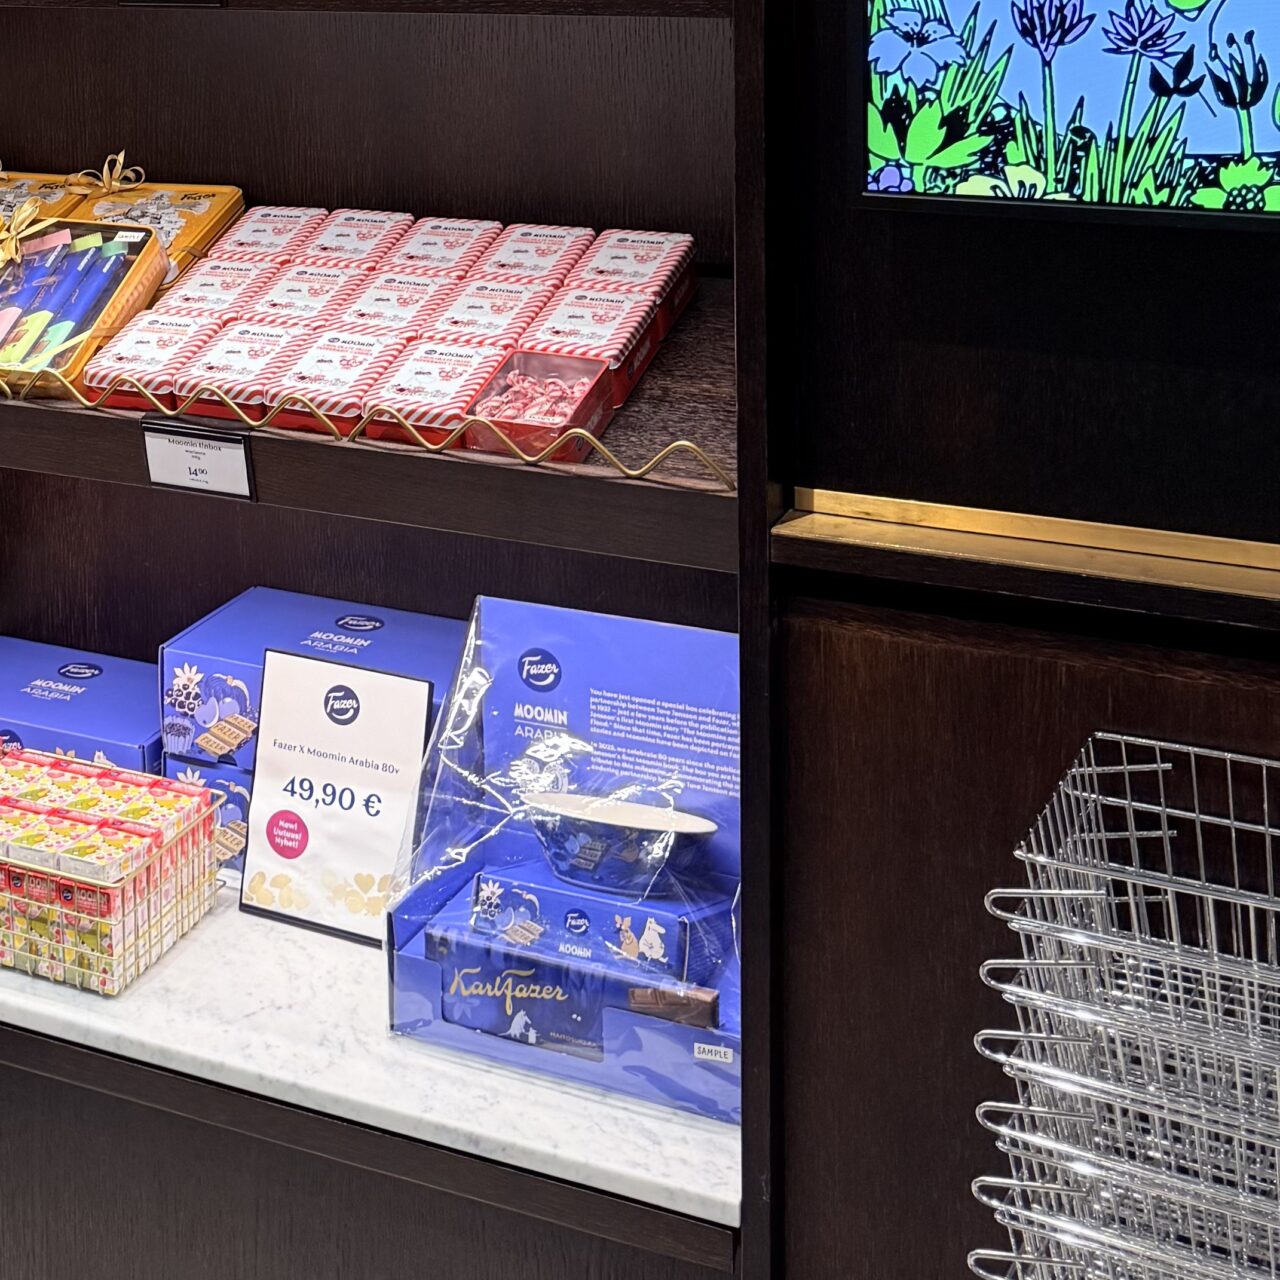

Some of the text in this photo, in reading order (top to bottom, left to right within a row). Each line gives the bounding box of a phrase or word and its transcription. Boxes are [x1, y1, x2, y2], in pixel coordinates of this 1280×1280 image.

[310, 631, 372, 647] MOOMIN
[300, 640, 358, 654] ARABIA
[521, 656, 559, 680] Fazer
[21, 687, 71, 701] ARABIA
[30, 679, 87, 694] MOOMIN
[327, 691, 358, 714] Fazer
[514, 703, 568, 725] MOOMIN
[214, 723, 241, 740] FAZER
[273, 739, 400, 775] Fazer X Moomin Arabia 80v
[282, 776, 382, 818] 49,90 €
[278, 818, 298, 831] New!
[273, 827, 302, 841] Uutuus!
[275, 836, 298, 850] Nyhet!
[559, 943, 592, 958] MOOMIN
[697, 1046, 729, 1060] SAMPLE
